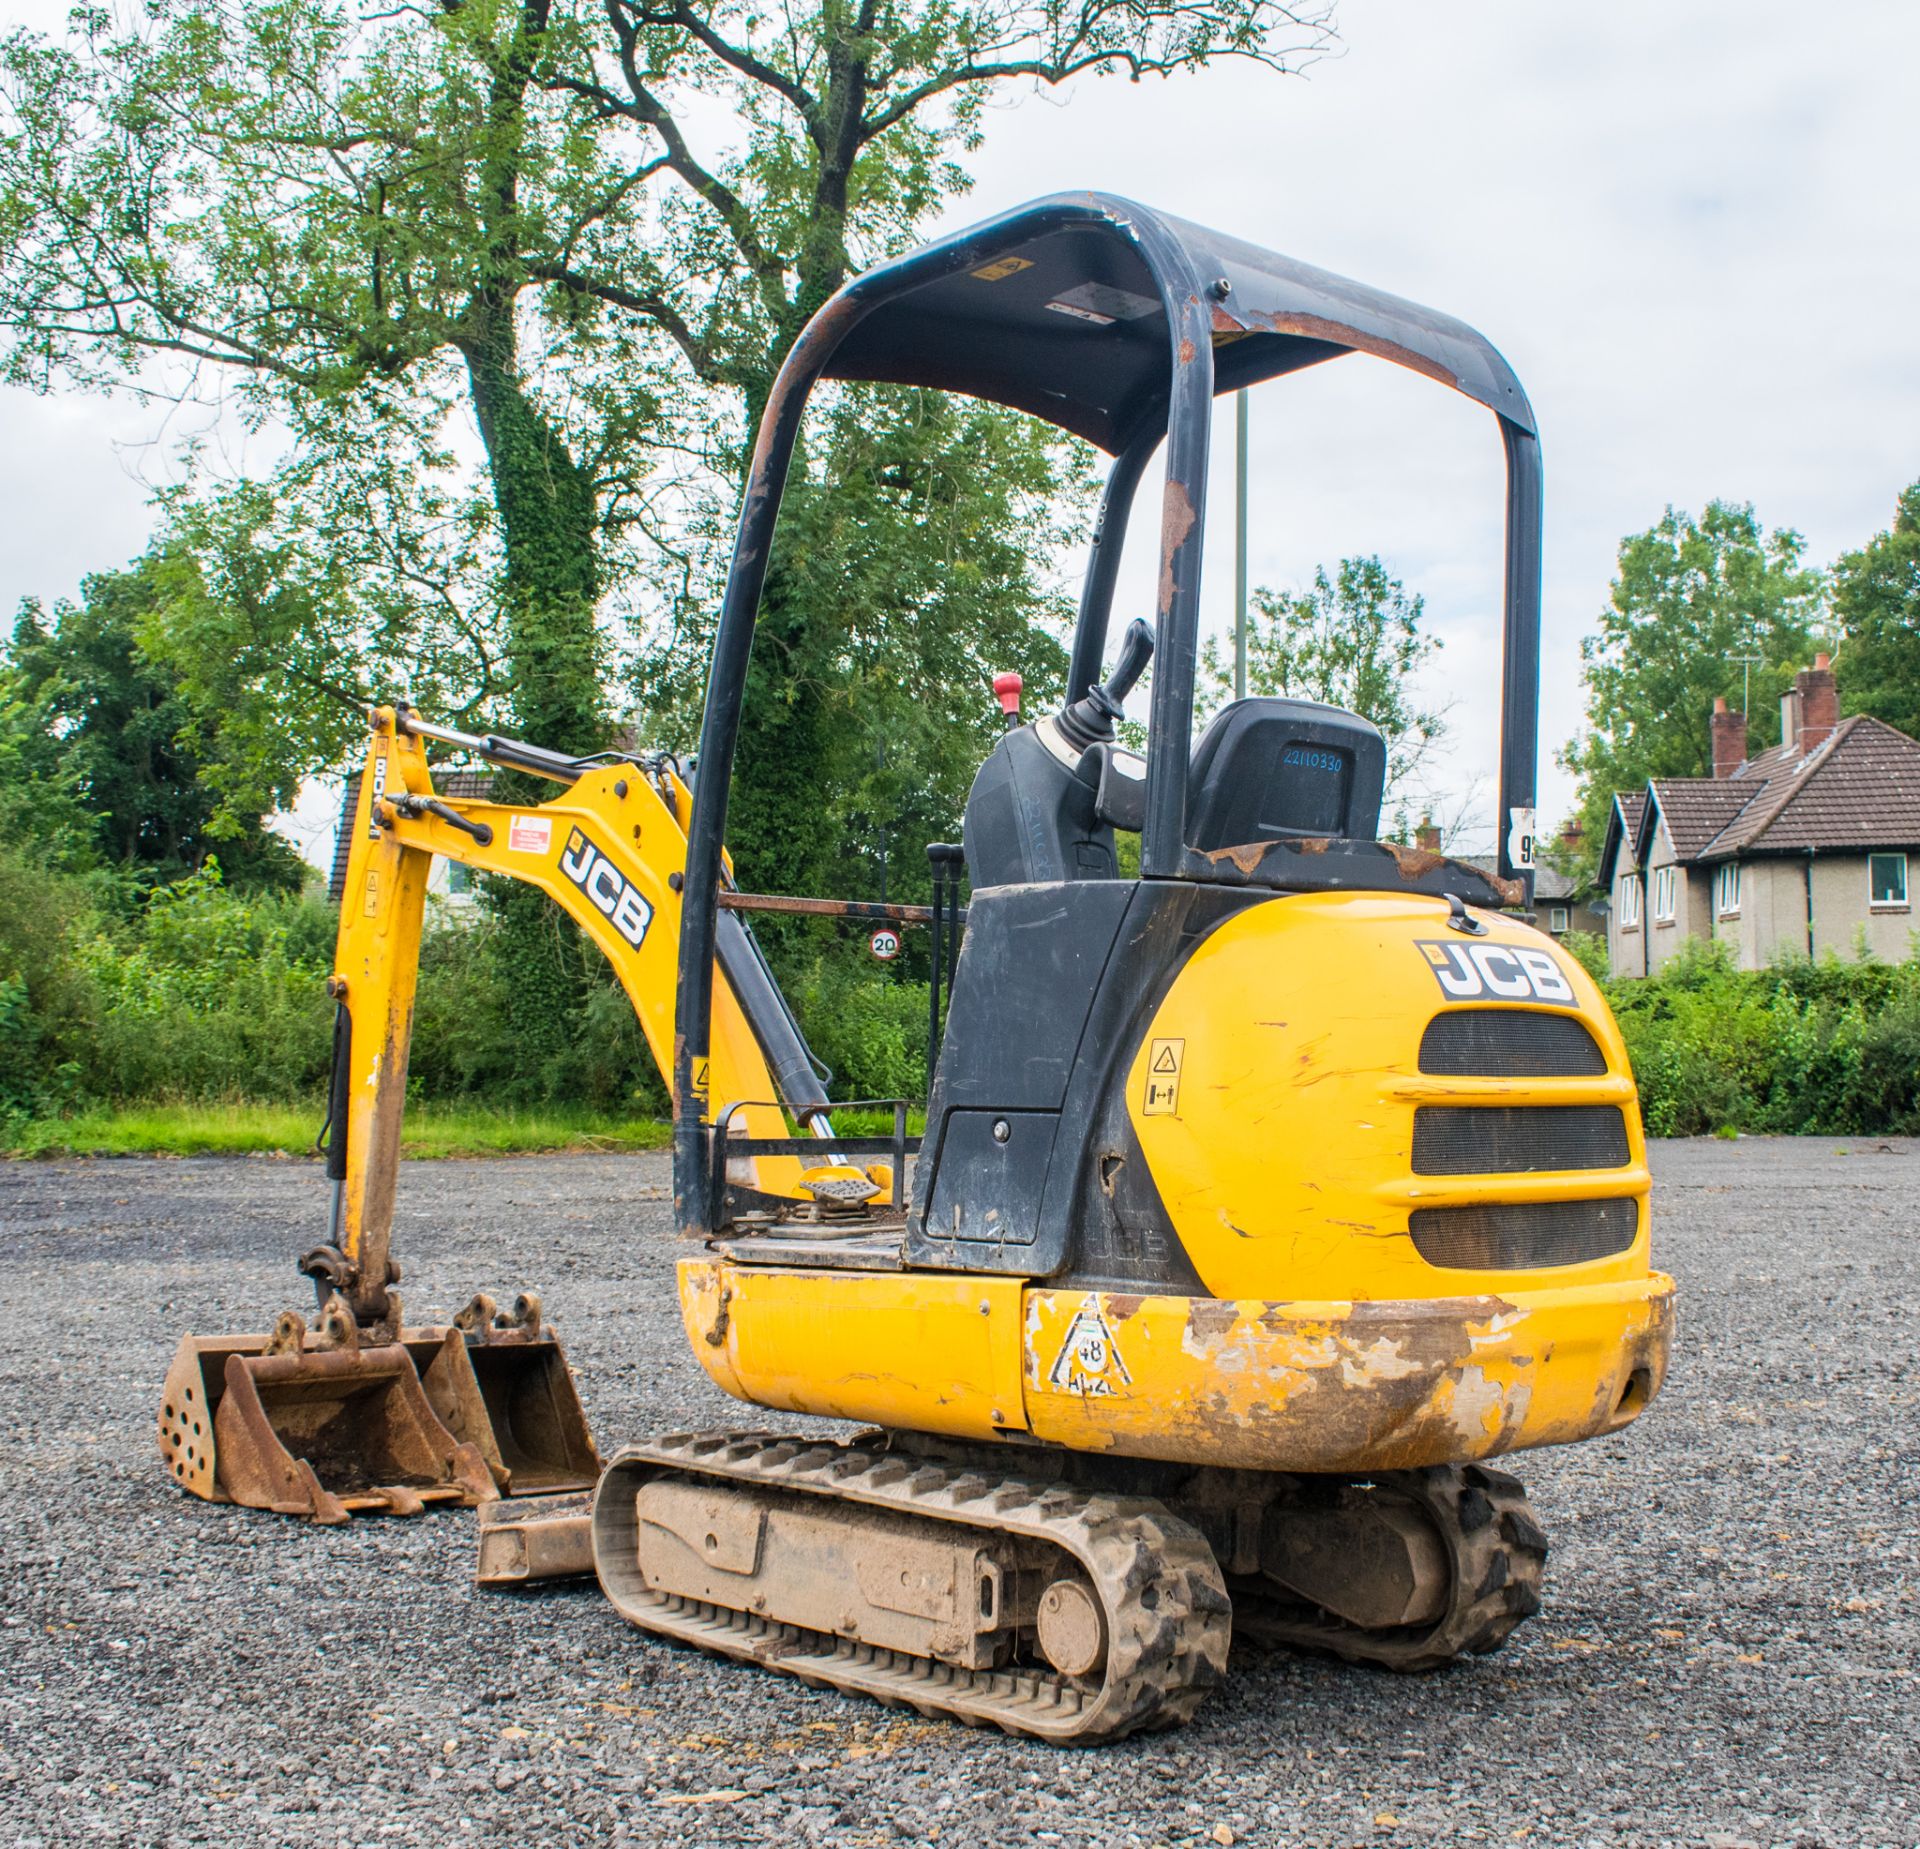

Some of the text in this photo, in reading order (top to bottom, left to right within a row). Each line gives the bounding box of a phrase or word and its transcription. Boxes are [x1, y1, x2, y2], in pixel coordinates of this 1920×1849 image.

[562, 844, 651, 945] JCB
[874, 938, 895, 951] 20
[1437, 944, 1573, 1001] JCB
